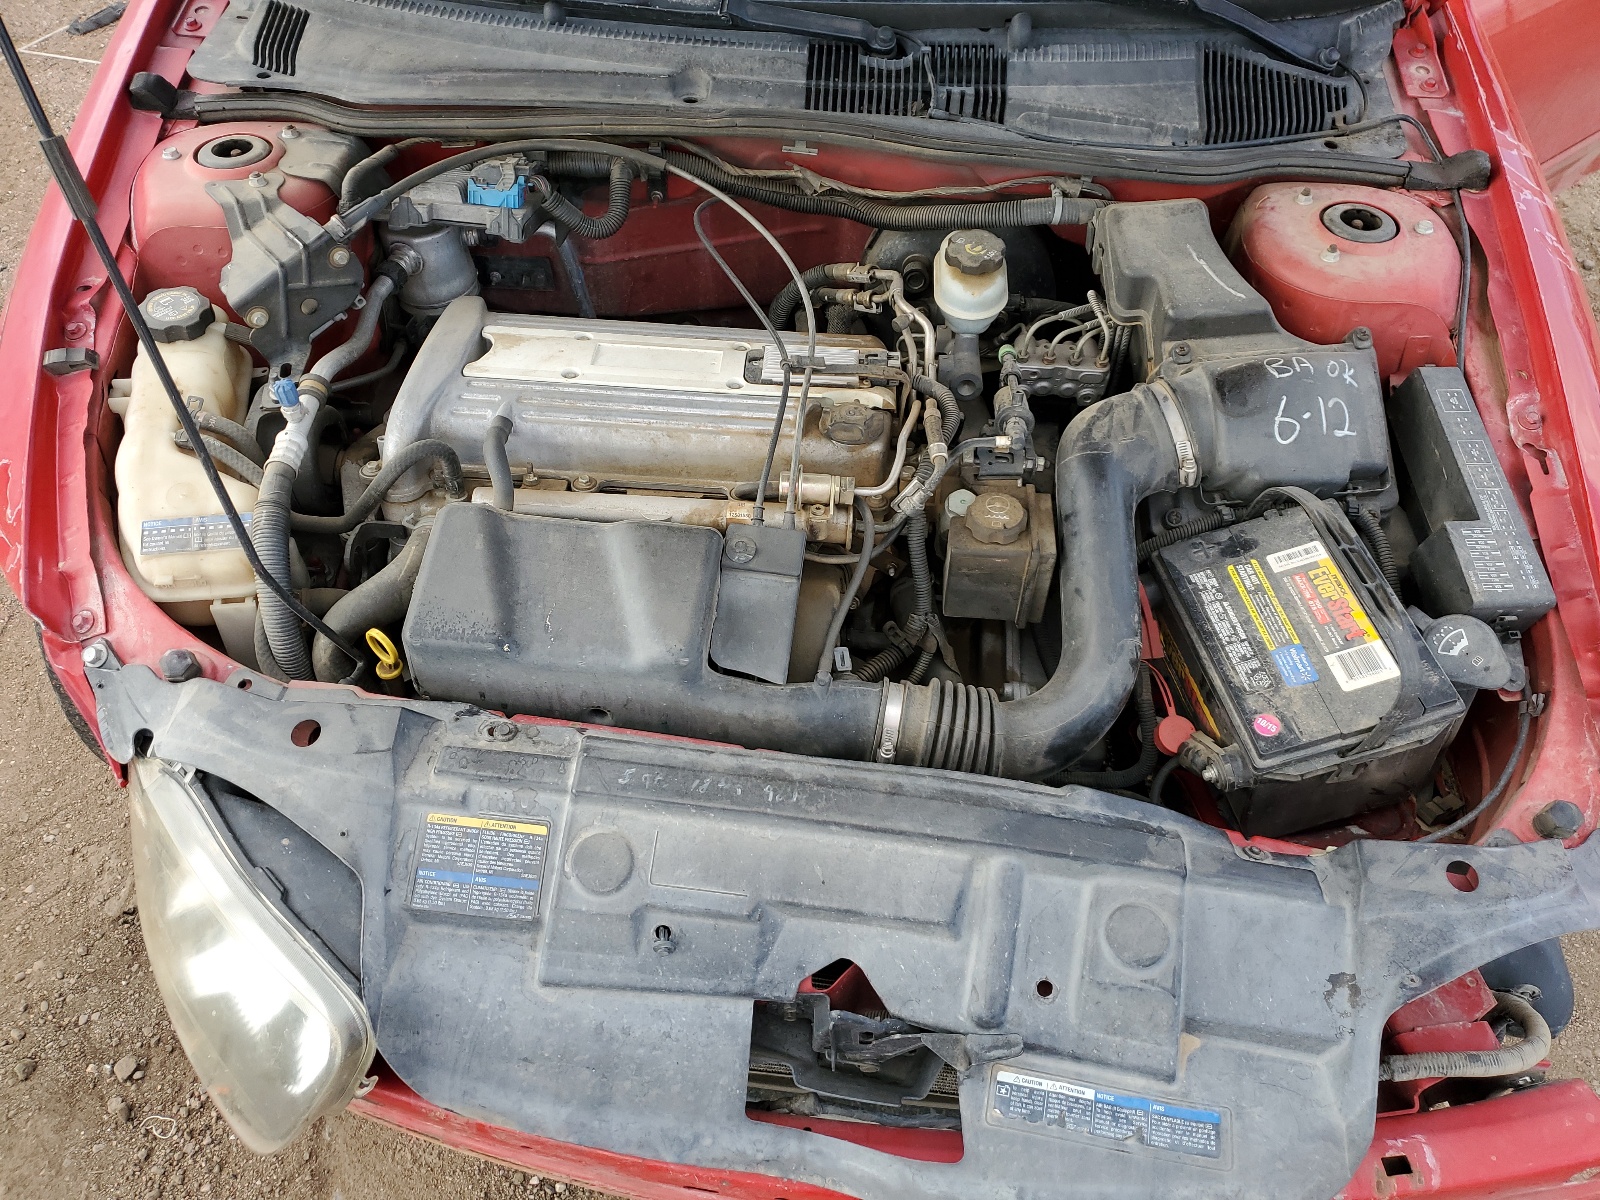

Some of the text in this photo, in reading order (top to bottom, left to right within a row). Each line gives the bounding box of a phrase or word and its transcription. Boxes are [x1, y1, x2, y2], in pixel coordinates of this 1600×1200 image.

[1308, 565, 1369, 641] EverStart
[1289, 647, 1305, 672] Walmart
[1256, 717, 1278, 733] 10/15
[1021, 1078, 1043, 1086] CAUTION
[1058, 1085, 1085, 1094] ATTENTION
